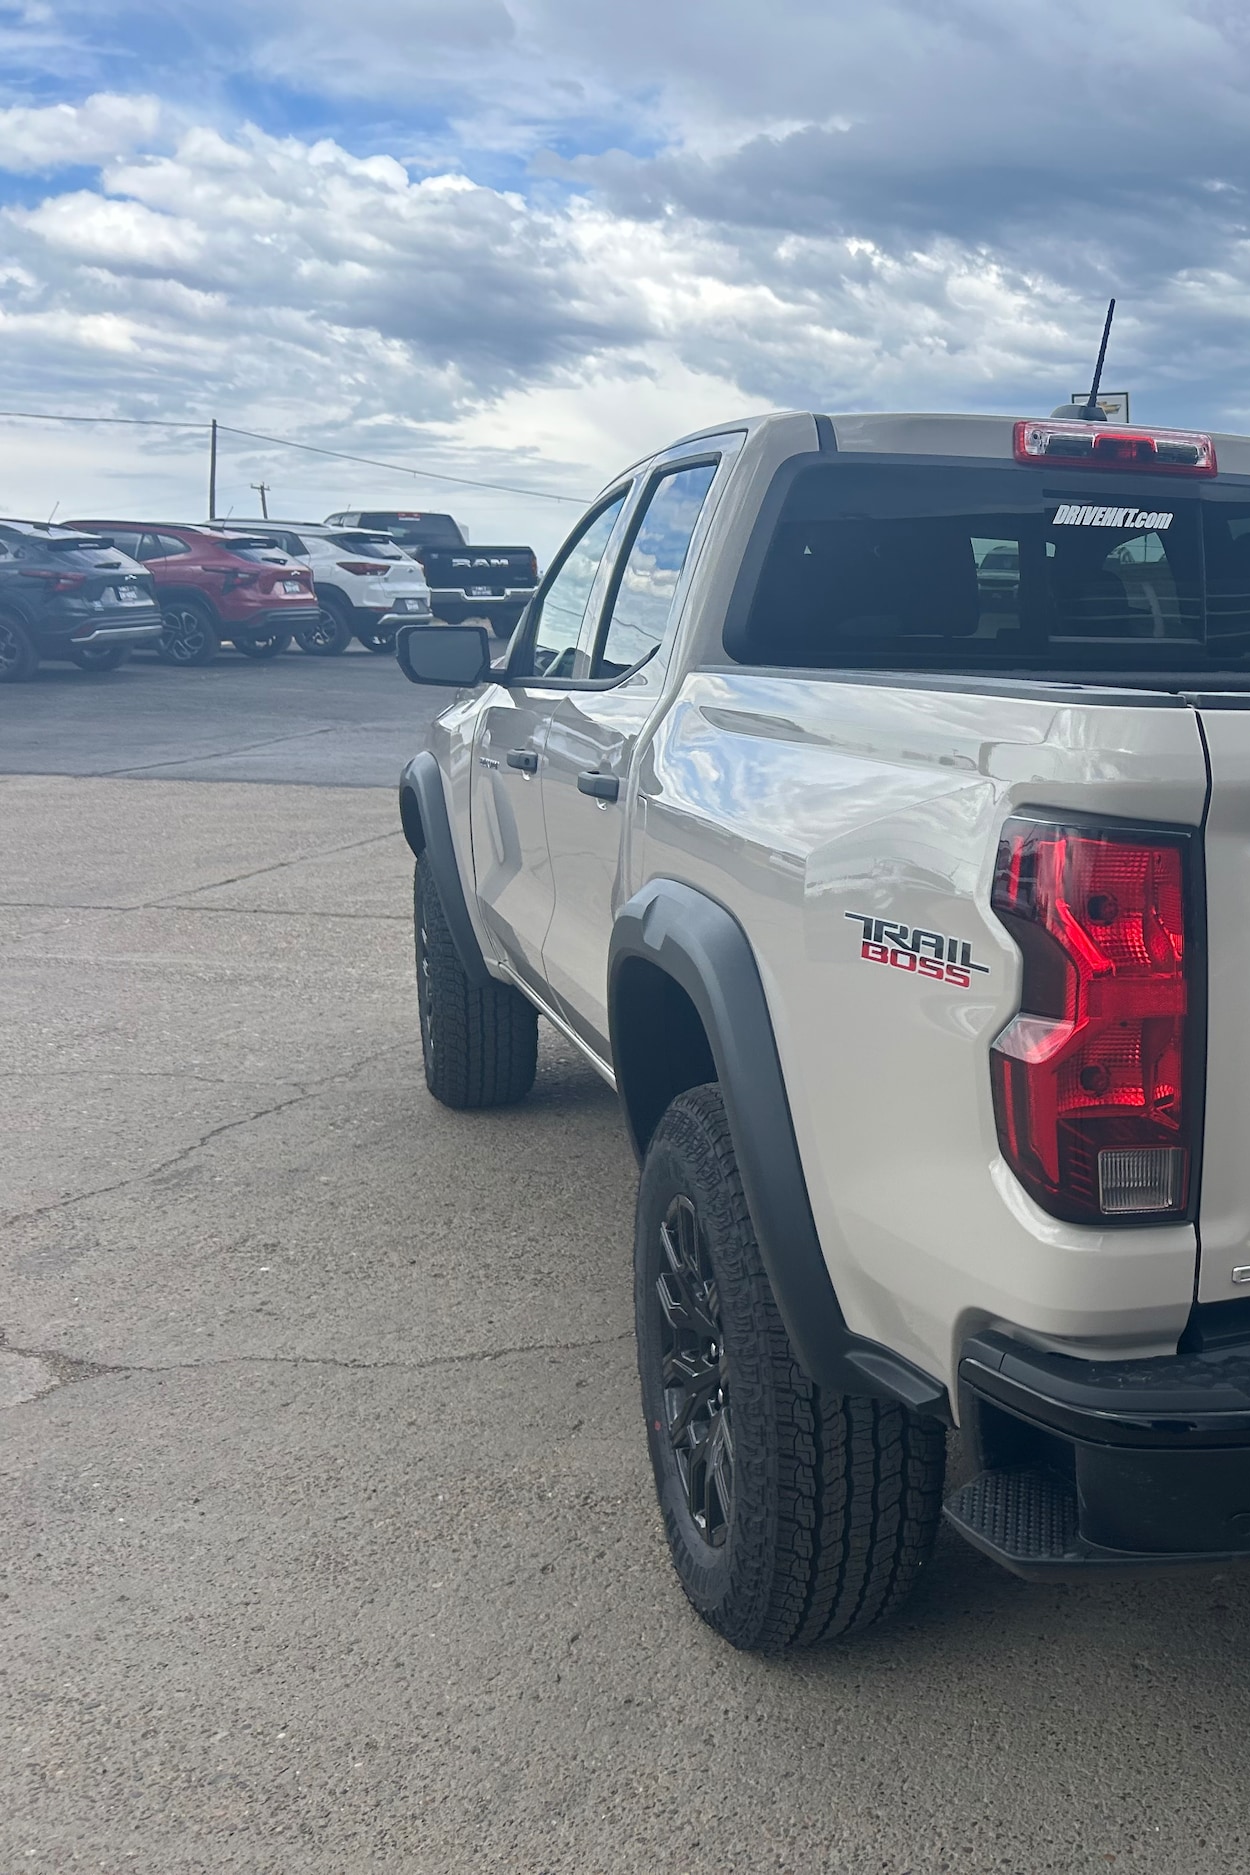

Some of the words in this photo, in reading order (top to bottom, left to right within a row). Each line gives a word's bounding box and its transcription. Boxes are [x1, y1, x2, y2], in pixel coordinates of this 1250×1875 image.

[1052, 504, 1174, 530] DRIVEHKT.com
[451, 558, 509, 568] RAM
[844, 911, 990, 974] TRAIL
[861, 940, 971, 988] BOSS
